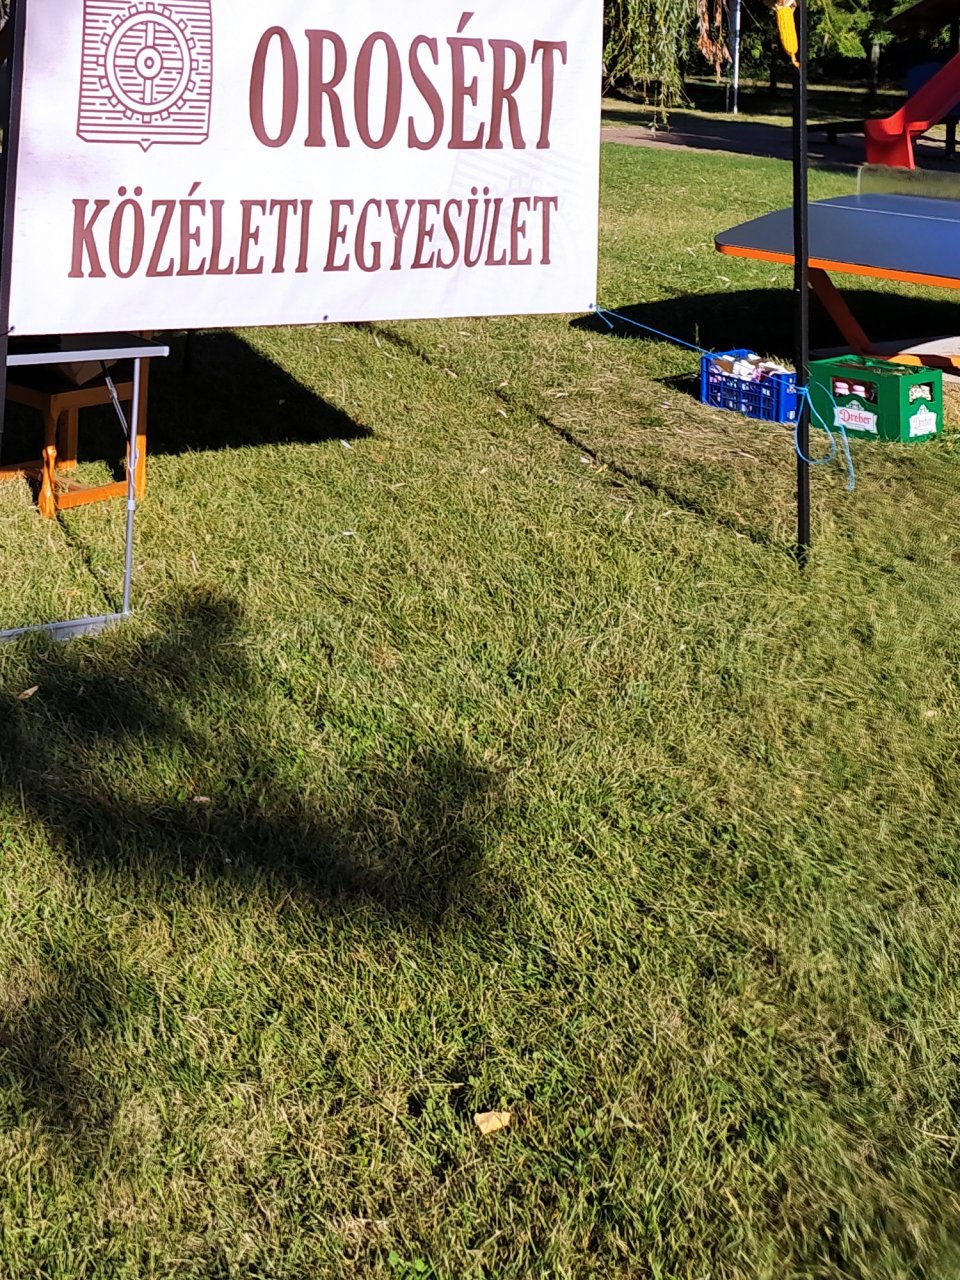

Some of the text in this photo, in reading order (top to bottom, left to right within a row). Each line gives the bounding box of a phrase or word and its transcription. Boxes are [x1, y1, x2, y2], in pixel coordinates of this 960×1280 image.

[248, 11, 568, 151] OROSÉRT
[67, 181, 559, 279] KÖZÉLETI EGYESÜLET
